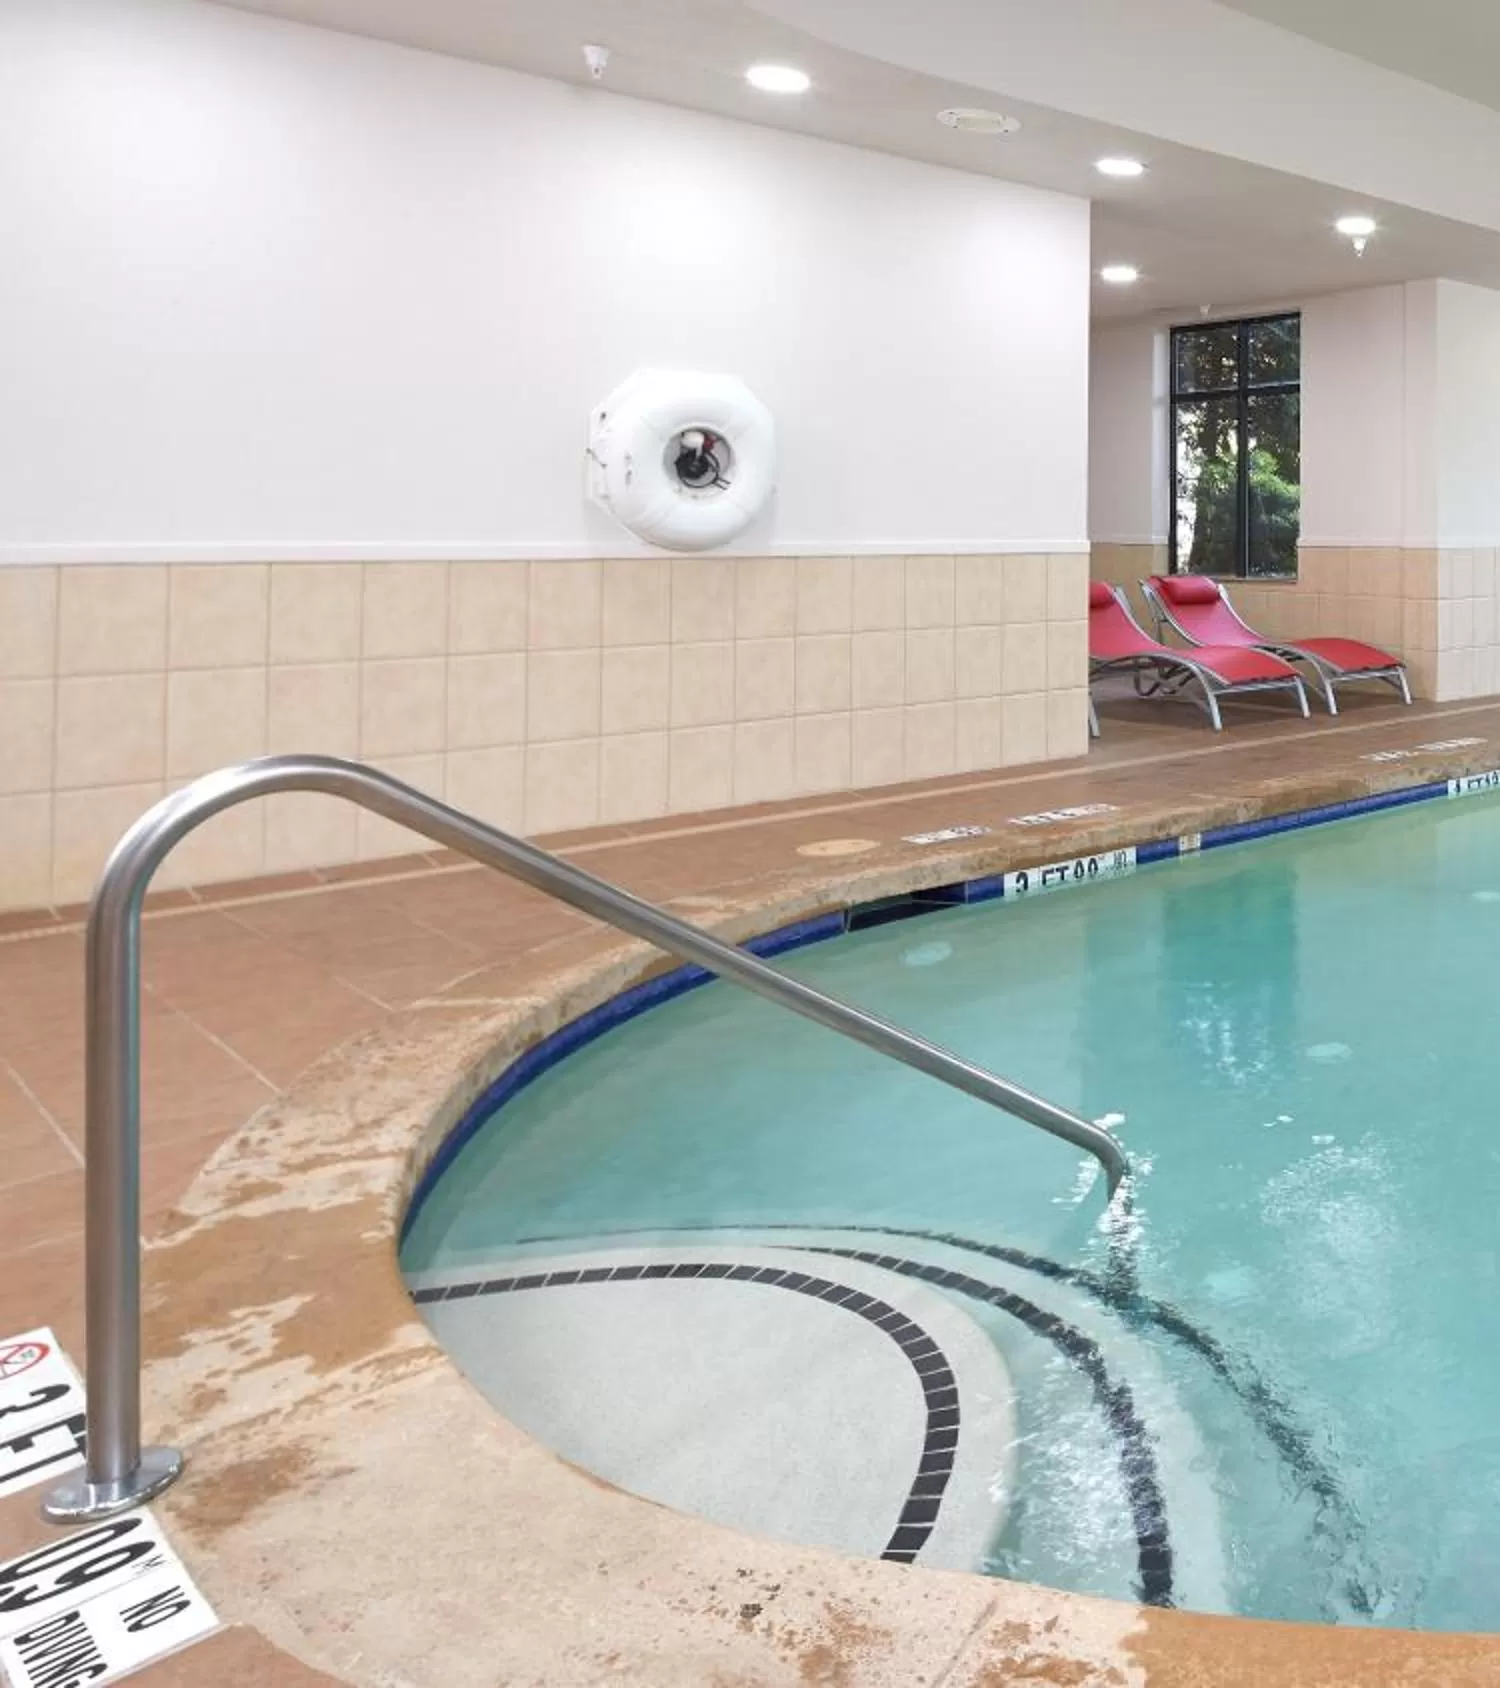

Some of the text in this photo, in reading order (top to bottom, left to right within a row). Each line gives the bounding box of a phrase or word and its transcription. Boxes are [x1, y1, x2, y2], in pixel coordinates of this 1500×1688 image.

[0, 1413, 87, 1484] FT
[119, 1585, 191, 1632] NO
[14, 1610, 108, 1688] DIVING
